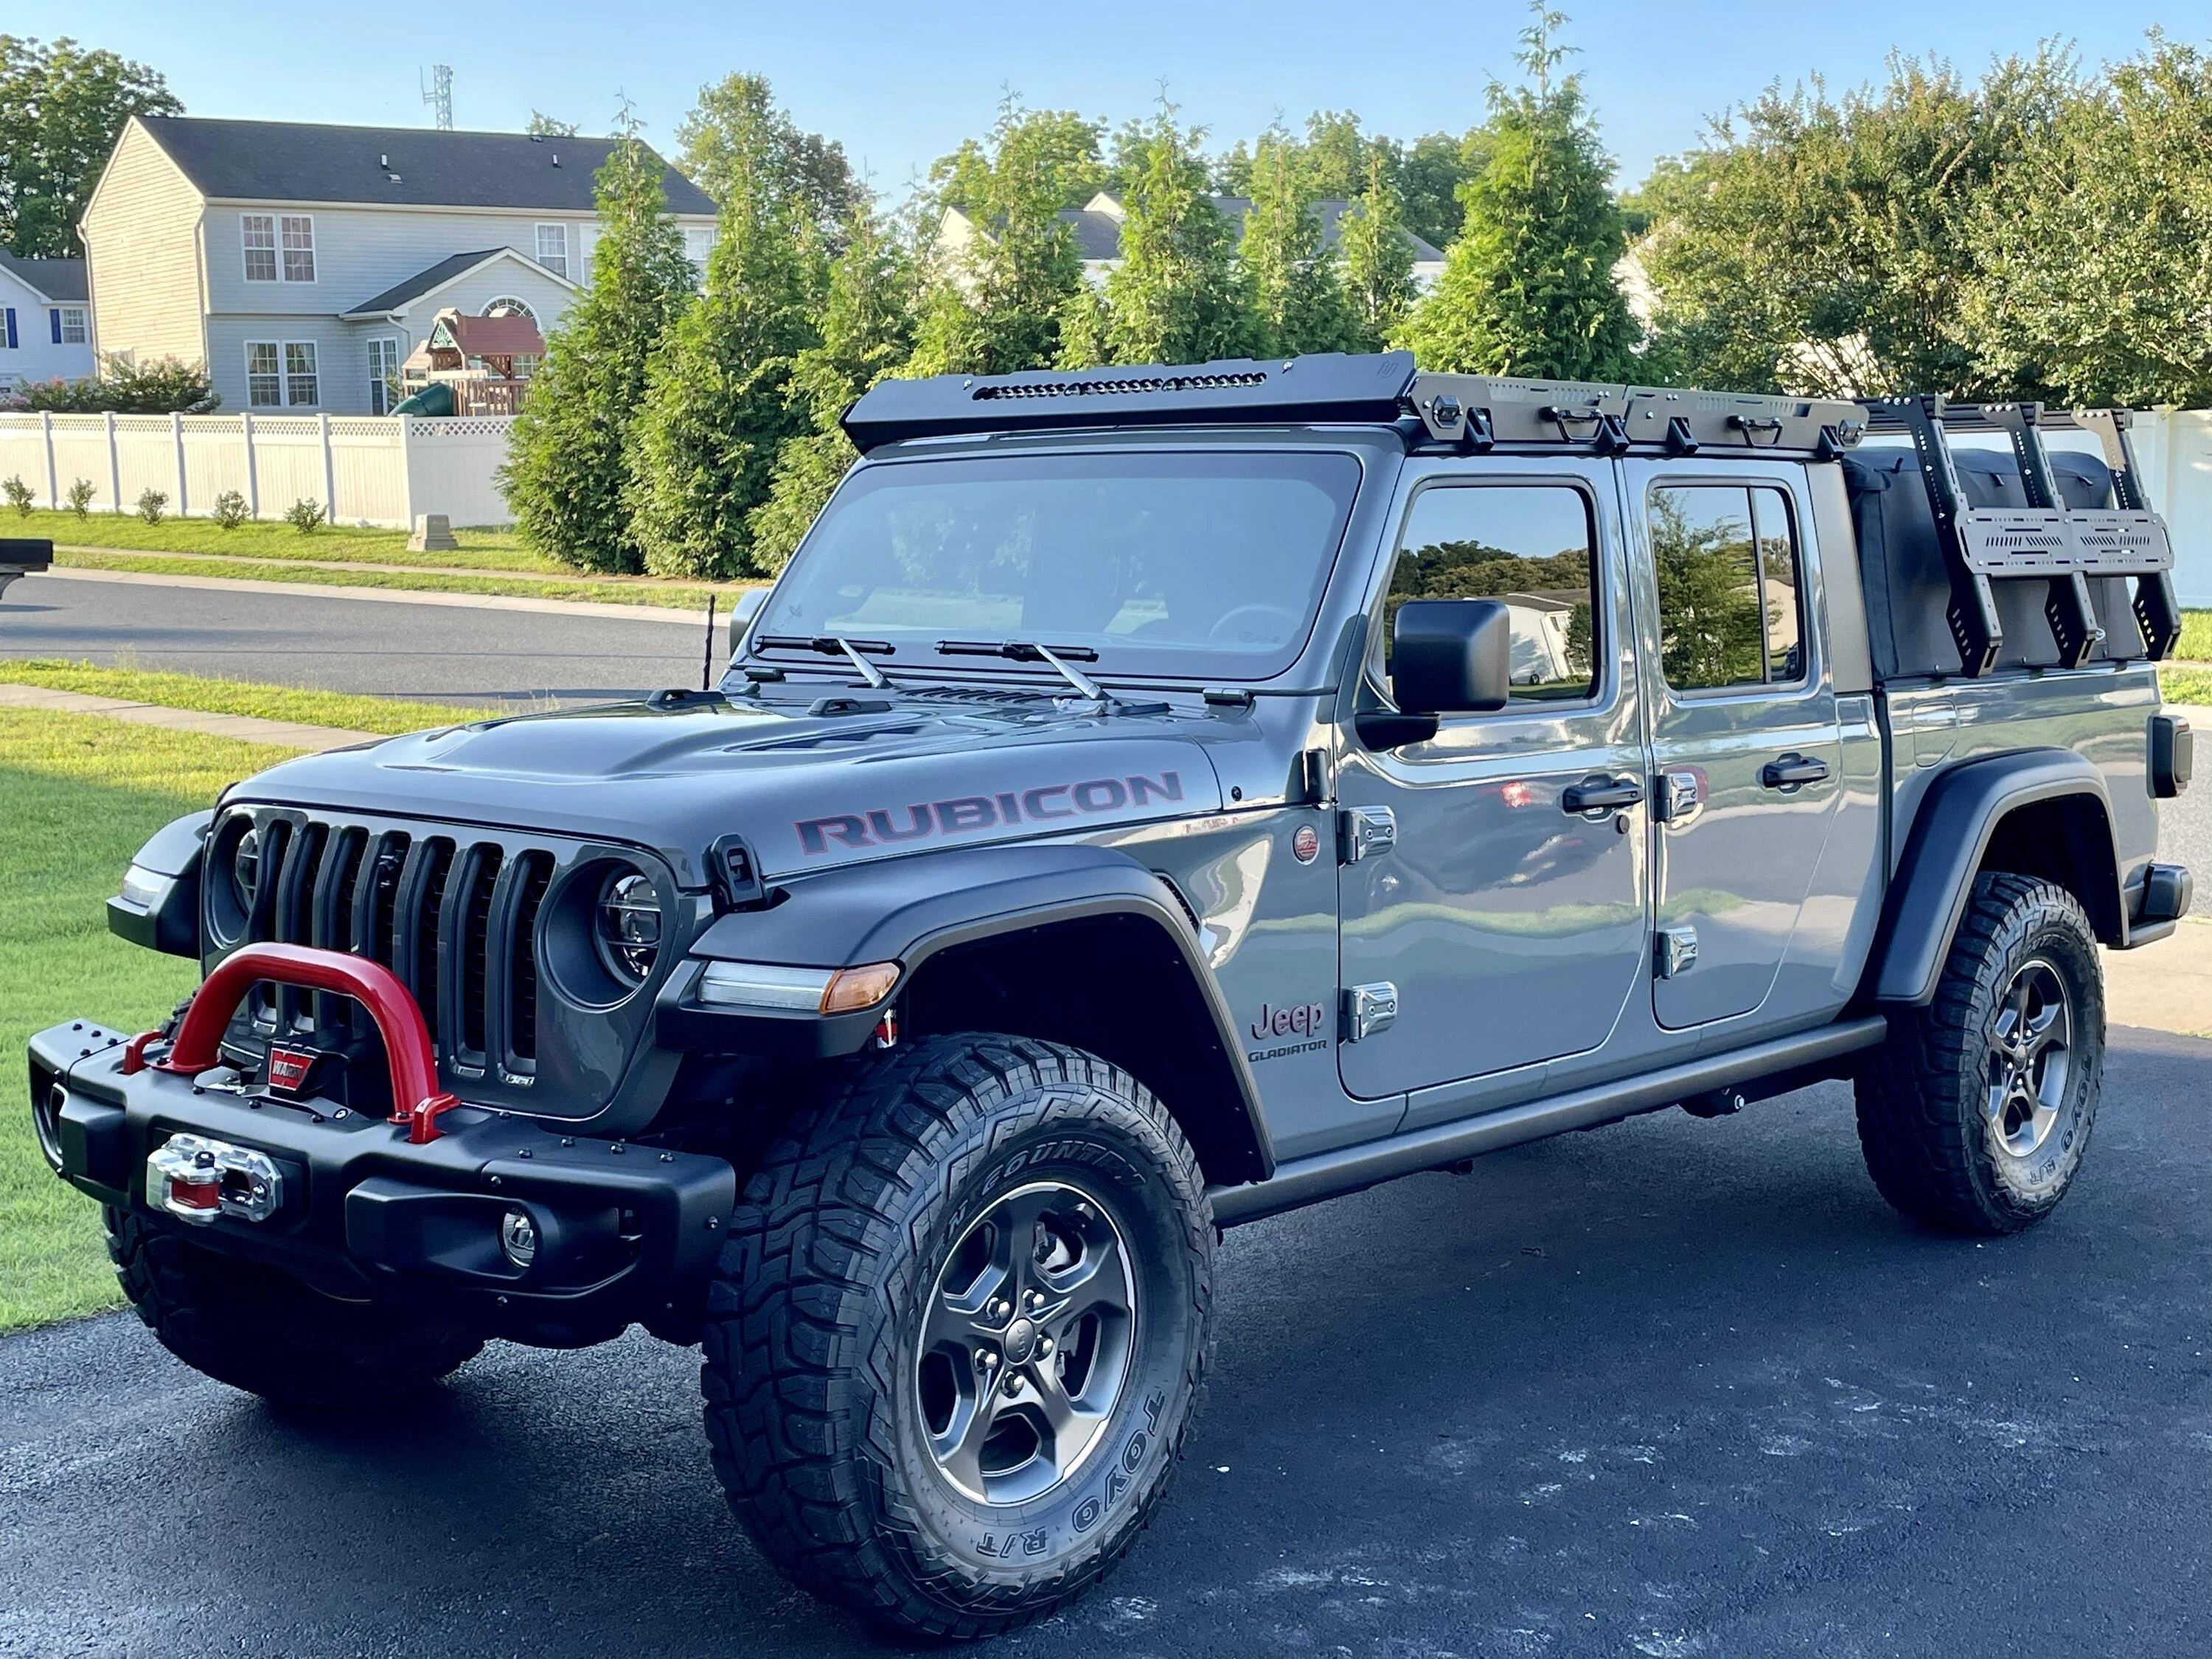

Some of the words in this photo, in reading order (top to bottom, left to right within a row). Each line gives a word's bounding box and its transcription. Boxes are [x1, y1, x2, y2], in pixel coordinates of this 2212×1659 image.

[793, 771, 1185, 856] RUBICON
[1252, 1002, 1324, 1039] Jeep
[1248, 1040, 1327, 1062] GLADIATOR
[2061, 1054, 2093, 1154] TOYO
[981, 1140, 1146, 1196] COUNTRY
[1071, 1391, 1166, 1533] TOYO
[975, 1526, 1048, 1558] R/T
